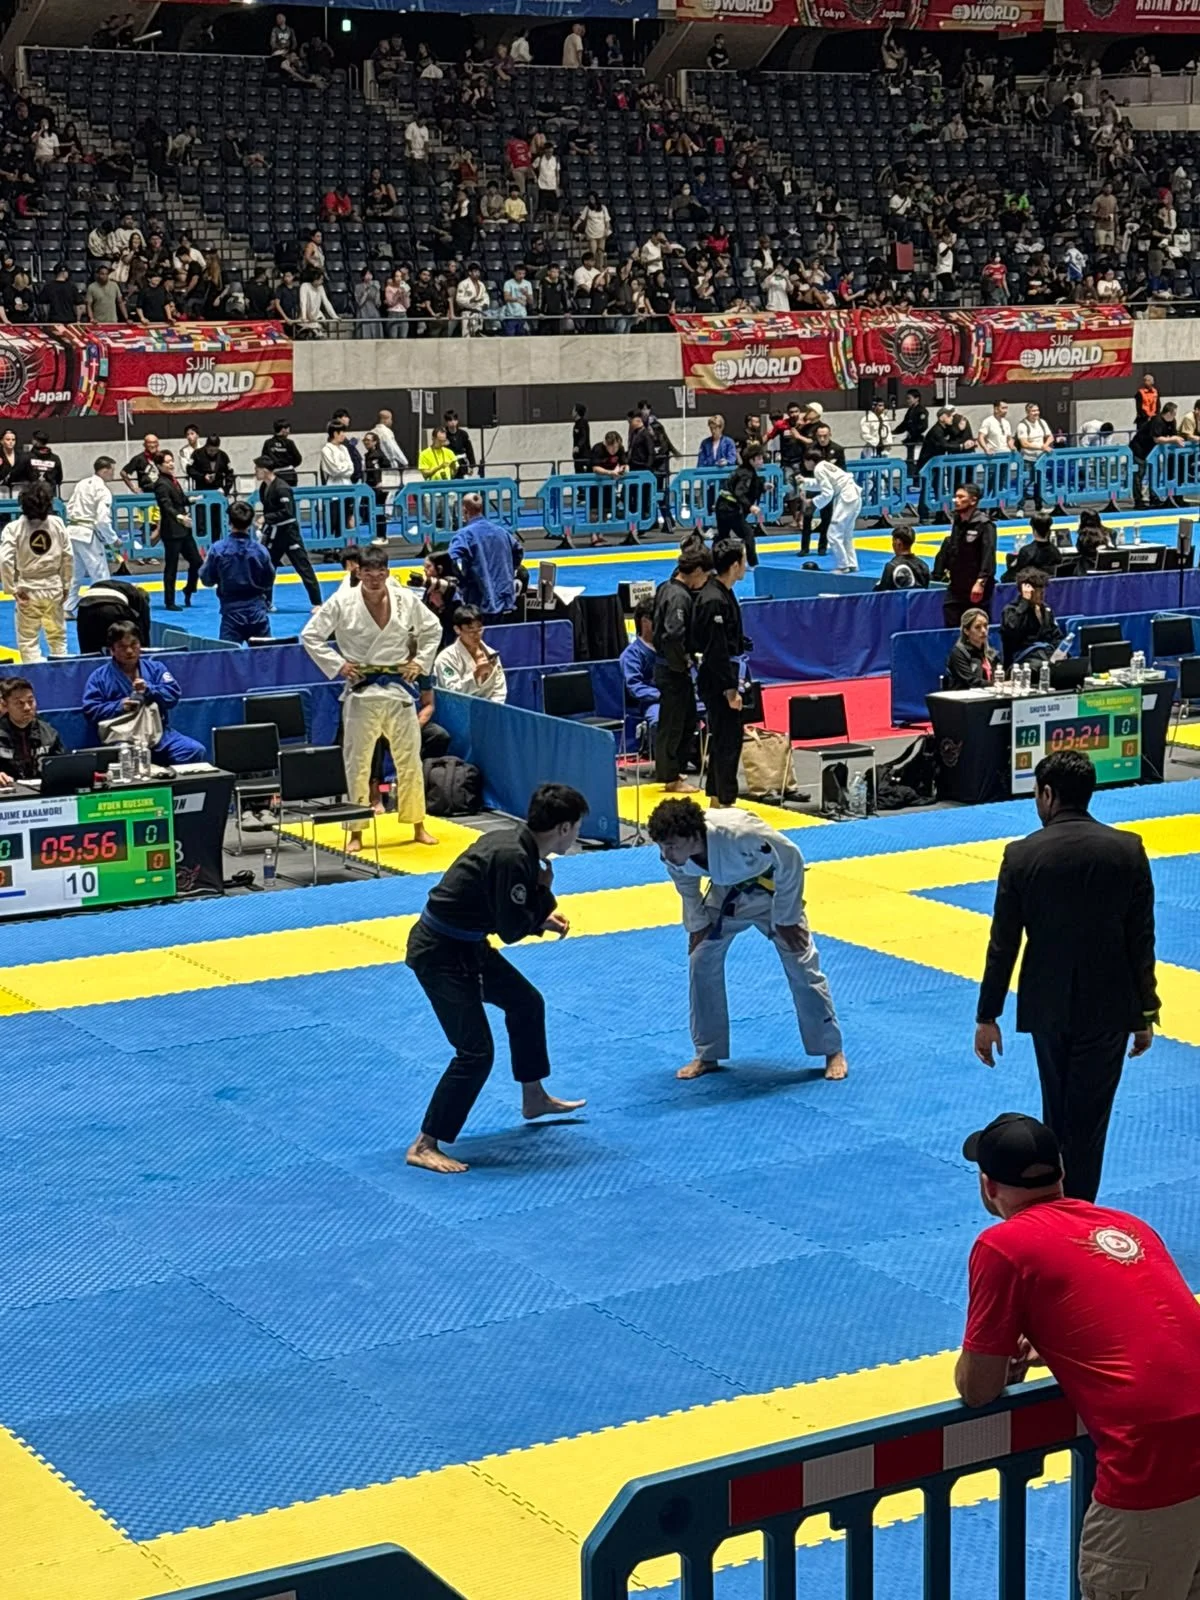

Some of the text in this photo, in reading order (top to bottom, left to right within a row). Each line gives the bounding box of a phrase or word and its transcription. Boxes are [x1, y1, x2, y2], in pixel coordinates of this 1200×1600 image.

[819, 8, 846, 19] Tokyo
[879, 9, 906, 19] Japan
[970, 5, 1020, 20] WORLD
[1049, 334, 1074, 347] SJJIF
[744, 343, 770, 357] SJJIF
[1042, 345, 1103, 367] WORLD
[186, 356, 216, 371] SJJIF
[738, 356, 802, 378] WORLD
[858, 362, 891, 377] Tokyo
[933, 362, 965, 376] Japan
[177, 370, 255, 395] WORLD
[30, 389, 71, 405] Japan
[1121, 718, 1131, 735] 0
[1020, 729, 1037, 746] 10
[1051, 723, 1101, 751] 03:21
[1126, 742, 1134, 756] 0
[22, 806, 63, 819] KANAMORI
[145, 824, 158, 844] 0
[0, 839, 11, 860] 0
[41, 831, 117, 865] 05:56
[153, 853, 164, 869] 0
[66, 871, 96, 895] 10
